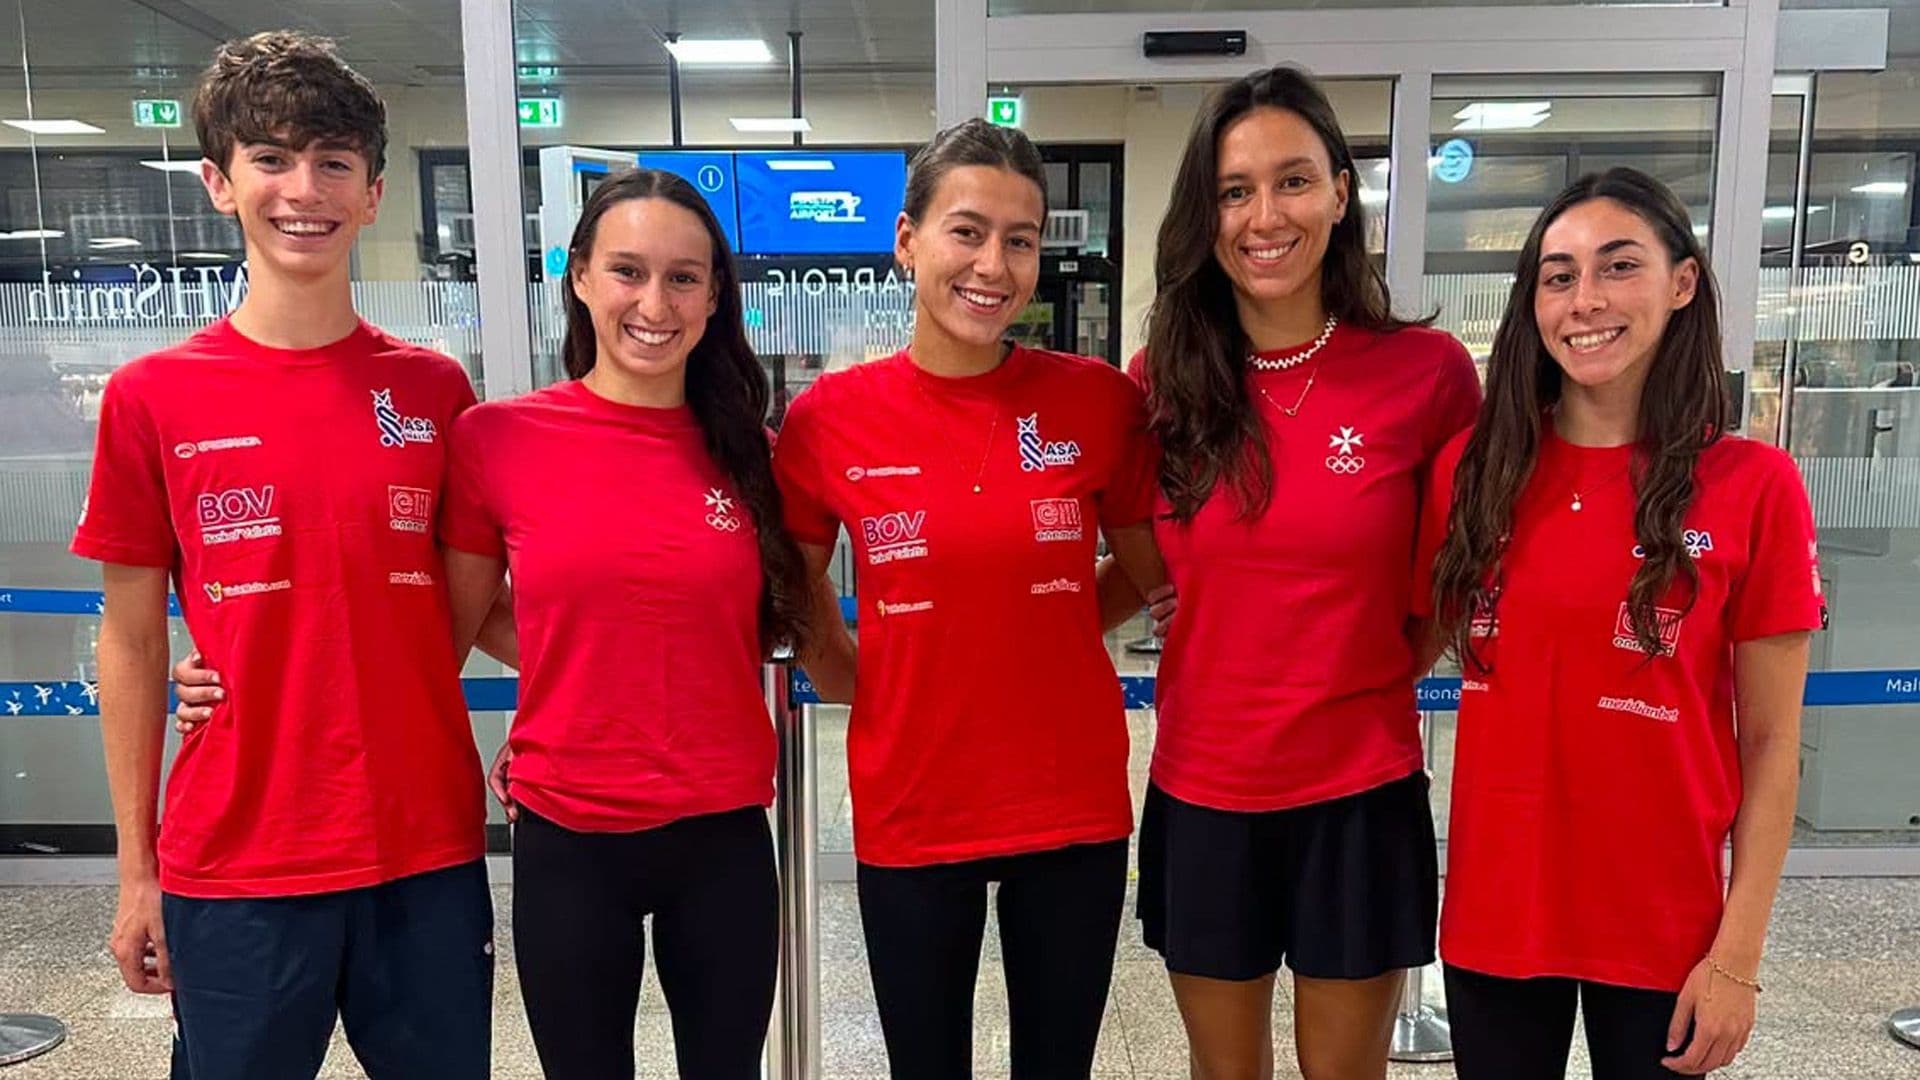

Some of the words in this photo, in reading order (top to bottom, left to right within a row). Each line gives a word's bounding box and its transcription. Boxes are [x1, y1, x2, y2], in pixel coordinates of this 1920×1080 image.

[404, 417, 436, 434] ASA
[1045, 441, 1080, 456] ASA
[198, 486, 274, 526] BOV
[861, 511, 925, 547] BOV
[1683, 530, 1713, 551] SA
[1886, 677, 1920, 692] Mal
[1598, 696, 1679, 722] meridianbet
